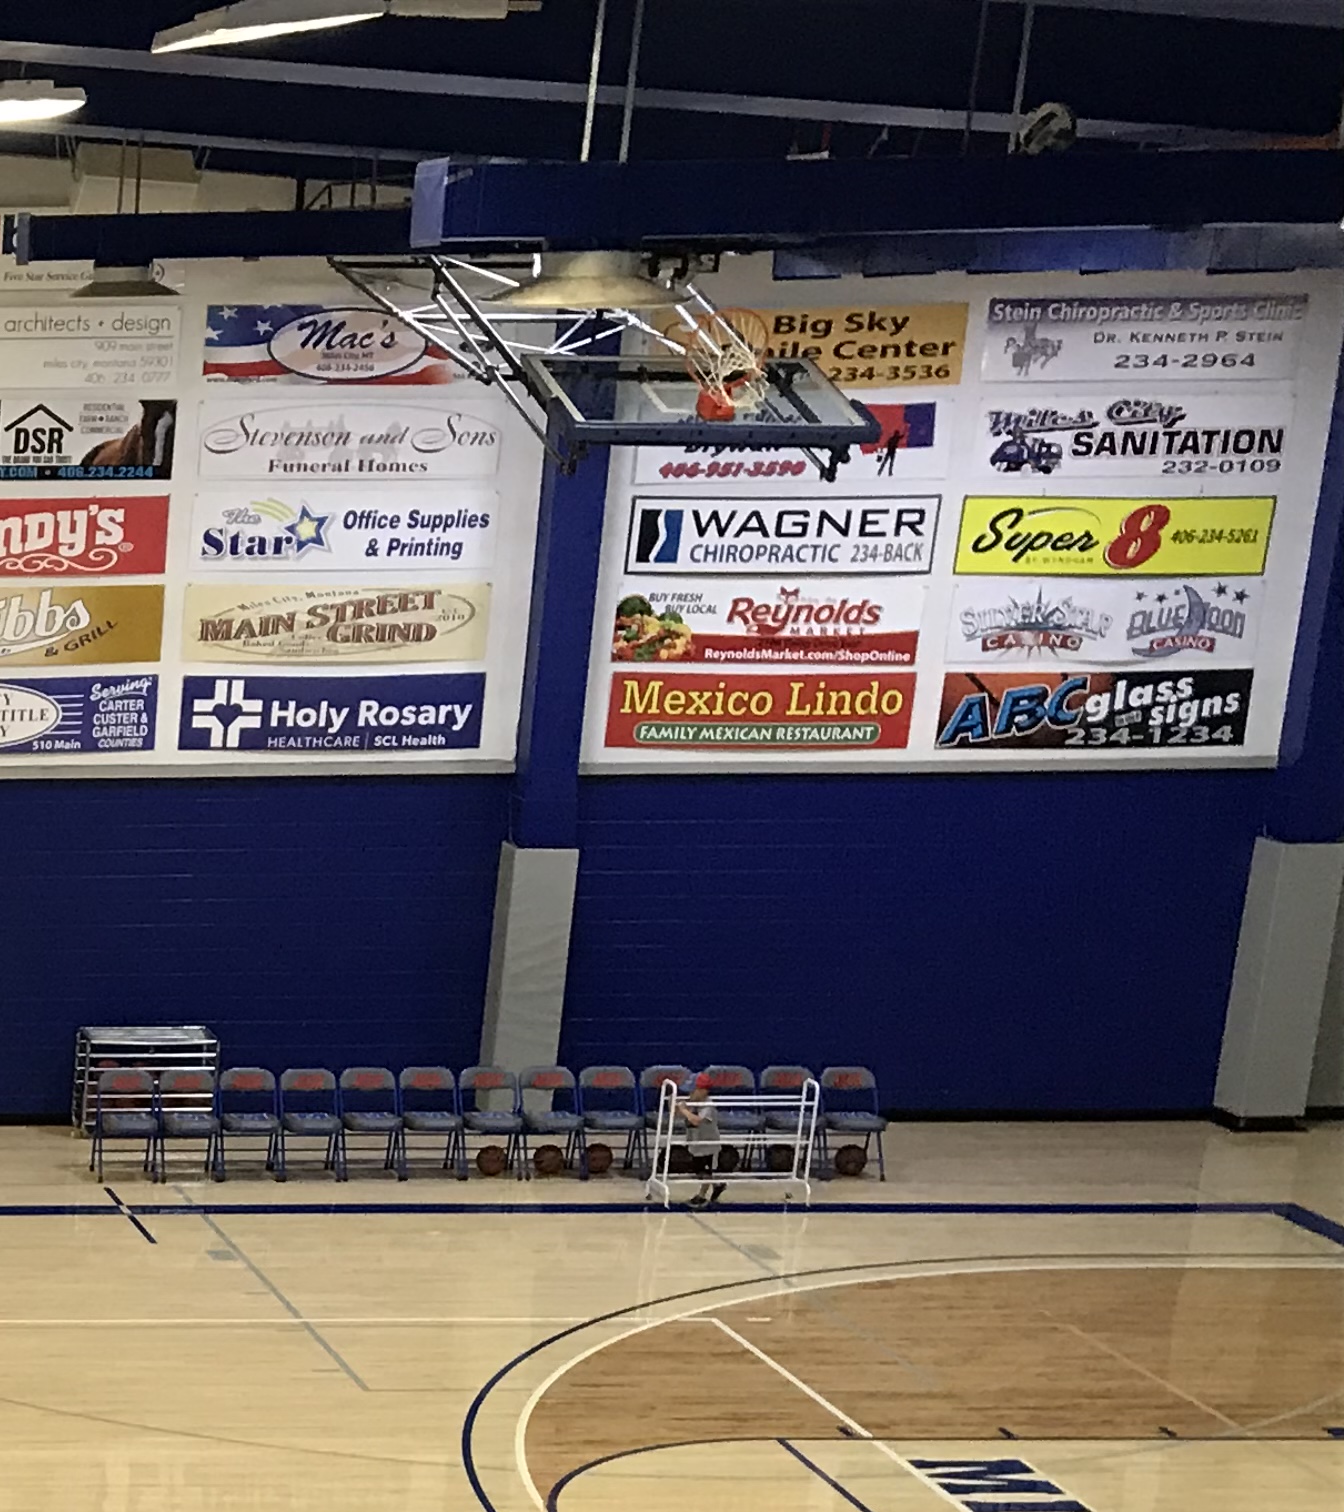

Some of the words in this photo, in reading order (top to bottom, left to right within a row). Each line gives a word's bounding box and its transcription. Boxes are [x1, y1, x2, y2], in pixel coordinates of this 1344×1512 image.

[993, 303, 1041, 320] Stein
[5, 315, 90, 332] architects
[299, 320, 398, 350] Mac's
[773, 315, 833, 338] Big
[844, 312, 910, 335] Sky
[1130, 331, 1209, 342] KENNETH
[1235, 331, 1283, 342] STEIN
[833, 340, 957, 359] Center
[14, 428, 64, 454] DSR
[203, 413, 351, 454] Stevenson
[411, 413, 497, 453] Sons
[1071, 429, 1284, 456] SANITATION
[268, 459, 349, 473] Funeral
[358, 459, 428, 473] Homes
[1162, 460, 1282, 474] 232-0109
[343, 511, 400, 530] Office
[407, 510, 490, 532] Supplies
[692, 509, 926, 538] WAGNER
[202, 528, 293, 558] Star
[386, 537, 463, 560] Printing
[972, 507, 1100, 563] Super
[1104, 505, 1170, 570] 8
[690, 544, 840, 564] CHIROPRACTIC
[198, 612, 296, 642] MAIN
[307, 589, 442, 628] STREET
[727, 597, 882, 630] Reynolds
[64, 620, 118, 652] GRILL
[99, 699, 144, 711] CARTER
[620, 680, 773, 716] Mexico
[786, 682, 903, 716] Lindo
[1, 709, 49, 722] TITLE
[93, 713, 138, 725] CUSTER
[270, 701, 348, 733] Holy
[357, 701, 473, 730] Rosary
[936, 677, 1090, 747] ABC
[1084, 677, 1194, 723] glass
[1148, 692, 1241, 728] signs
[92, 725, 147, 737] GARFIELD
[267, 736, 360, 747] HEALTHCARE
[374, 735, 398, 746] SCL
[402, 734, 446, 745] Health
[640, 727, 696, 740] FAMILY
[699, 727, 772, 740] MEXICAN
[776, 726, 875, 740] RESTAURANT
[54, 739, 81, 750] Main
